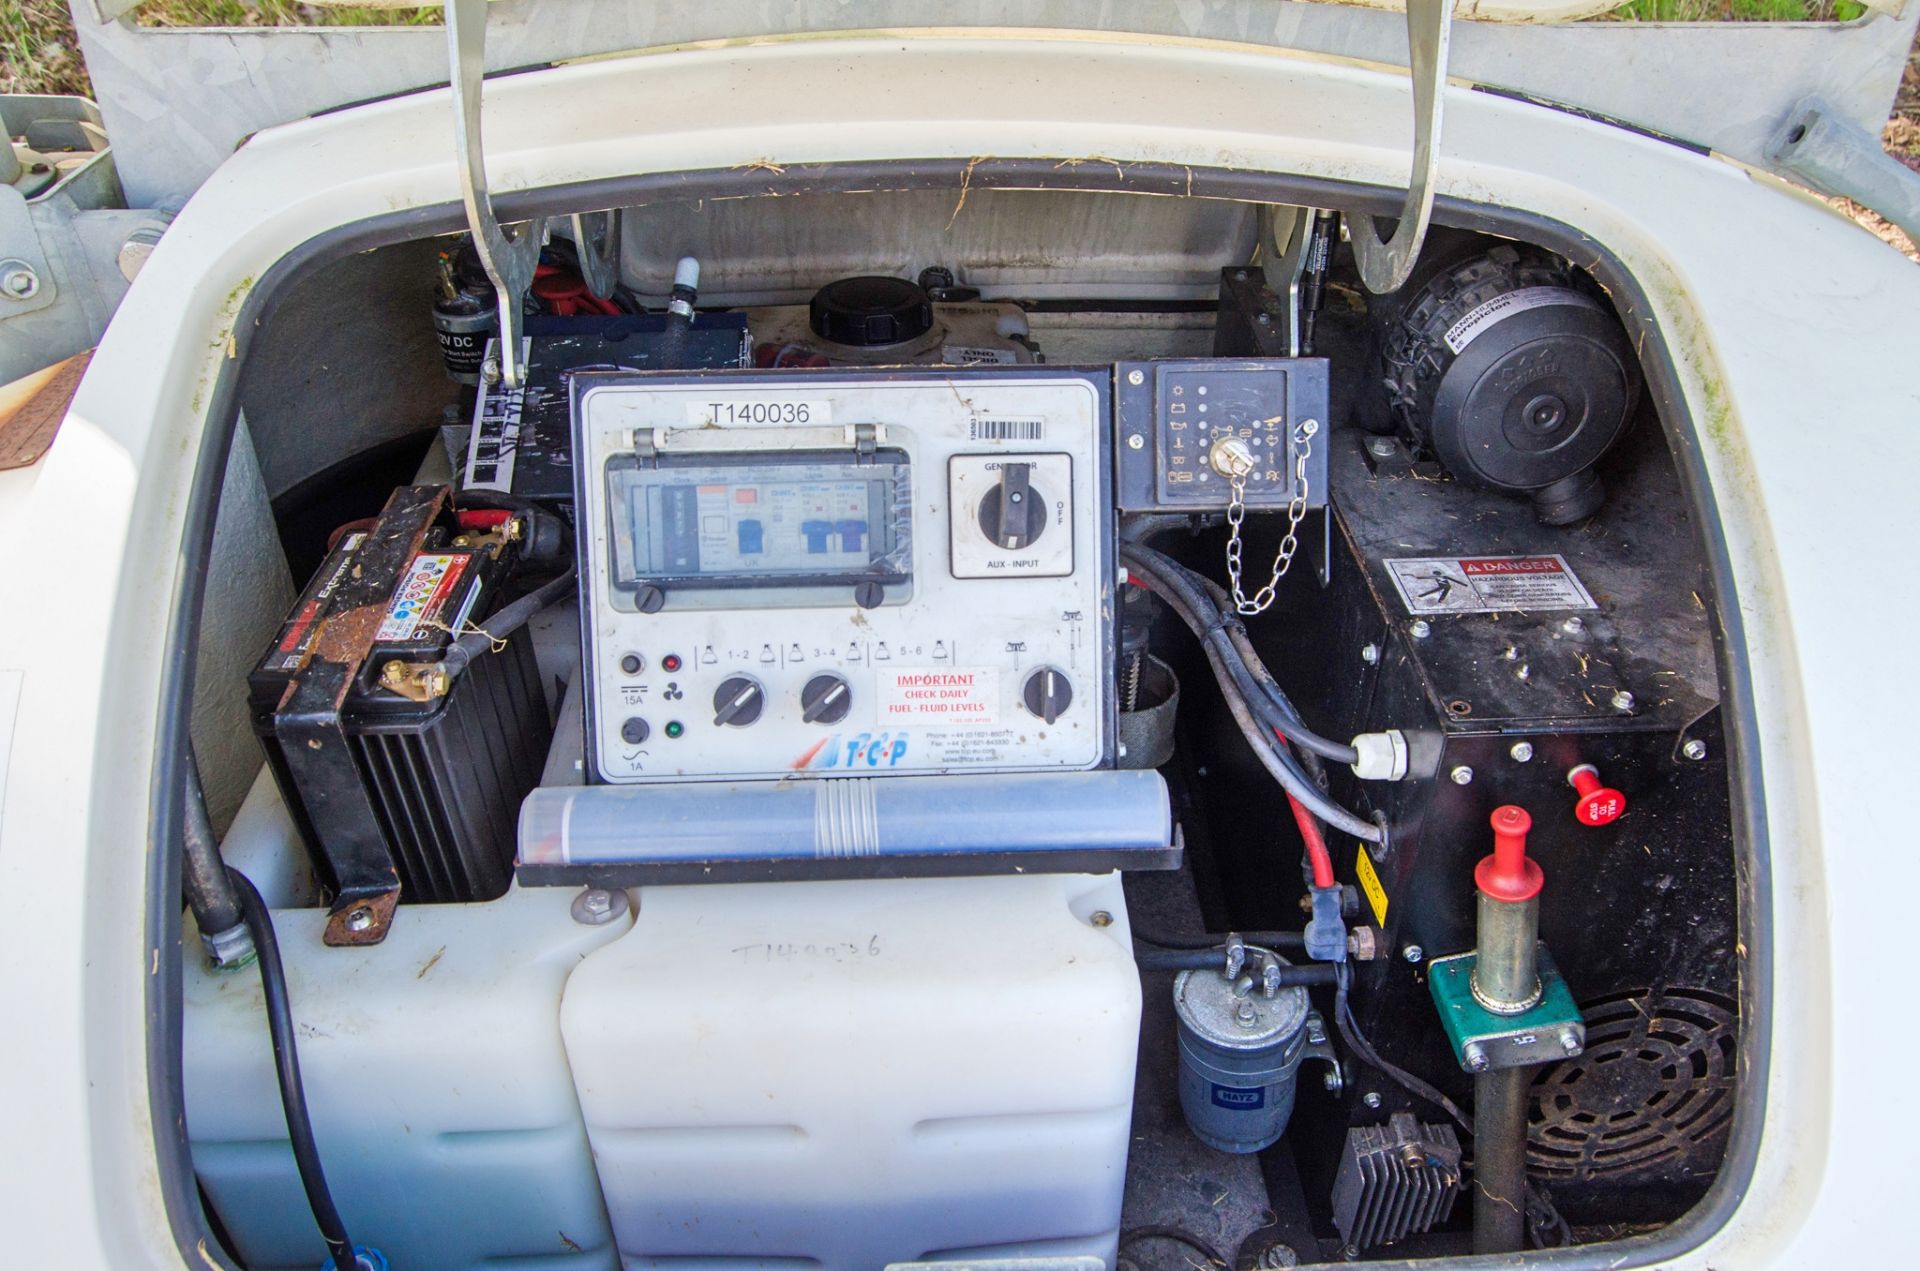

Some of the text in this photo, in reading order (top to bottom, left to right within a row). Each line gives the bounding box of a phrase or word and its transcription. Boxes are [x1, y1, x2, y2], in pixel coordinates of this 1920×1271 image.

[1450, 300, 1512, 343] Europiclon
[453, 336, 473, 348] DC
[963, 349, 995, 357] ONLY
[709, 402, 810, 424] T140036
[1012, 560, 1039, 568] INPUT
[1482, 560, 1556, 572] DANGER
[1527, 573, 1566, 581] VOLTAGE
[897, 674, 974, 686] IMPORTANT
[624, 696, 643, 705] 15A
[905, 690, 968, 699] CHECK DAILY
[889, 704, 912, 713] FUEL
[920, 703, 947, 712] FLUID
[951, 703, 985, 711] LEVELS
[630, 763, 643, 771] 1A
[1590, 802, 1598, 821] STOP
[1599, 804, 1607, 816] TO
[1608, 799, 1616, 817] PULL
